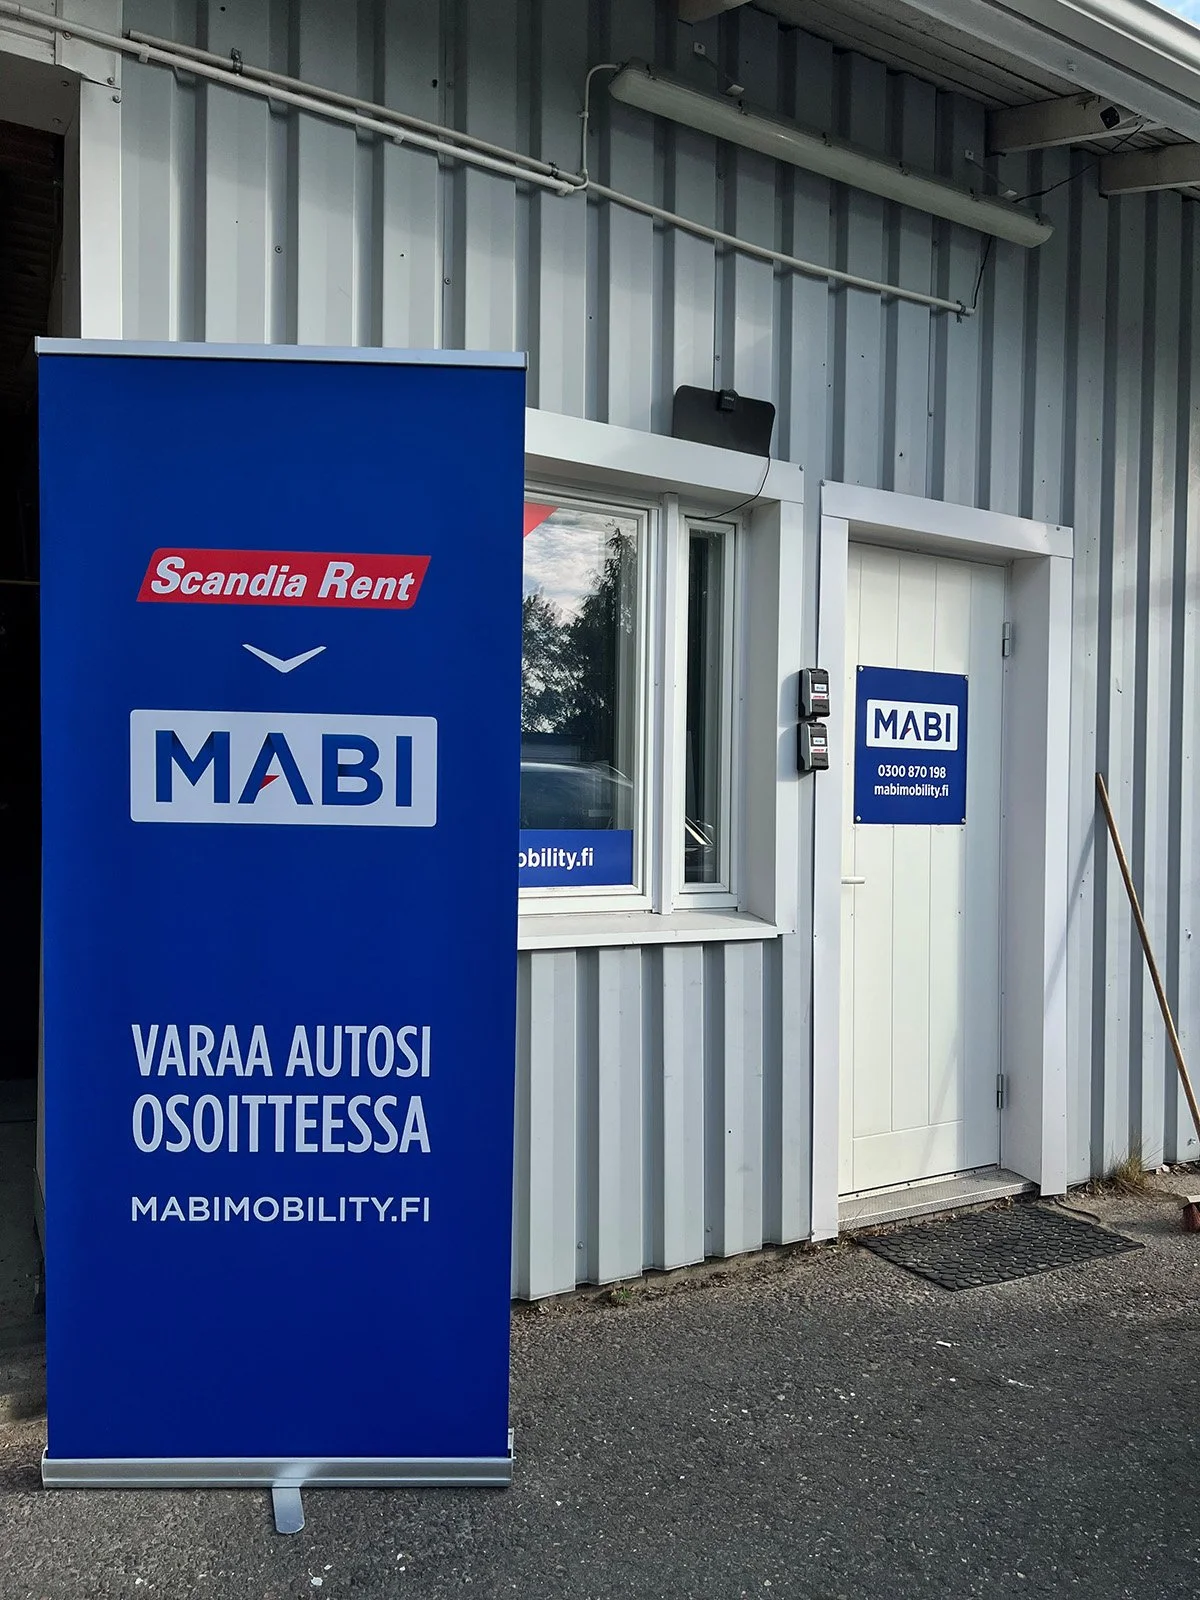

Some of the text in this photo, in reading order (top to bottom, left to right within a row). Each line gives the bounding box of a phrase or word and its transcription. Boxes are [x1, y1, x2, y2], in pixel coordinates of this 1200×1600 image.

[150, 556, 414, 601] Scandia Rent
[874, 708, 951, 743] MABI
[154, 729, 413, 808] MABI
[877, 764, 946, 779] 0300 870 198
[874, 783, 949, 798] mabimobility.fi
[131, 1024, 431, 1077] VARAA AUTOSI
[132, 1094, 431, 1153] OSOITTEESSA
[131, 1196, 430, 1222] MABIMOBILITY.FI
